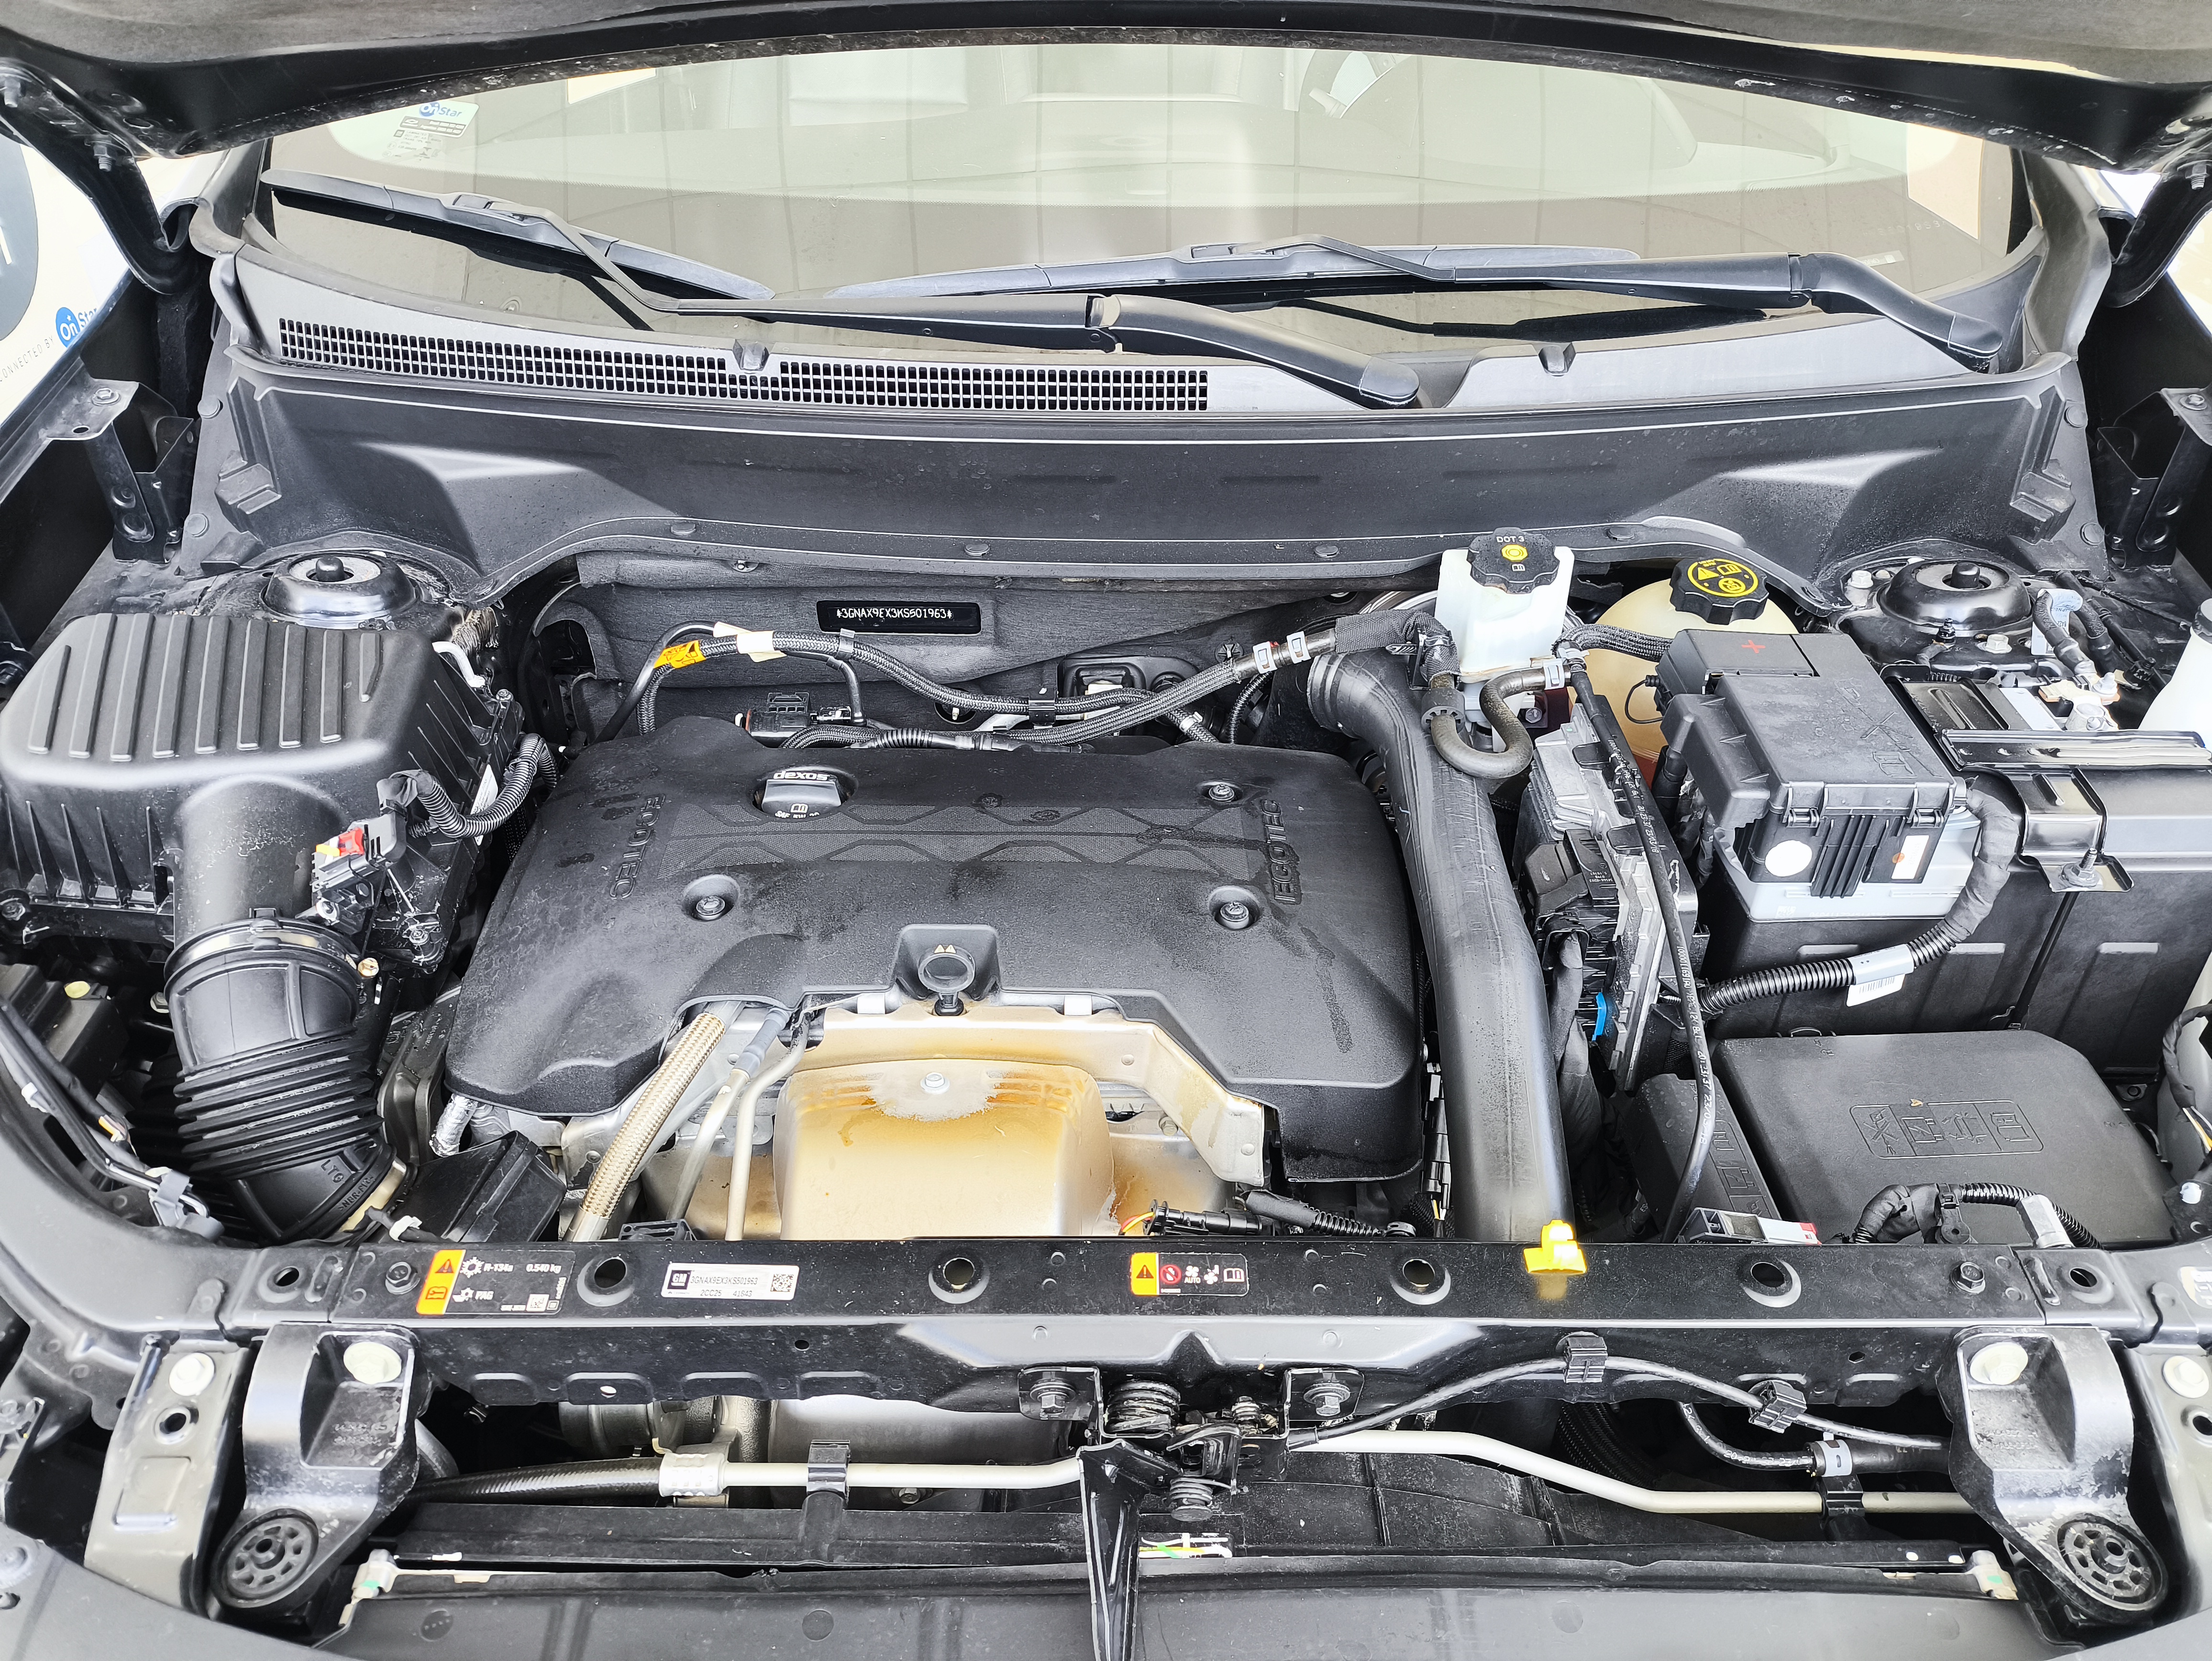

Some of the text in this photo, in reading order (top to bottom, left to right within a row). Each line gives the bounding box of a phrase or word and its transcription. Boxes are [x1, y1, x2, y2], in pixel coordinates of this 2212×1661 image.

[419, 102, 462, 117] OnStar
[44, 335, 55, 348] BY
[773, 771, 830, 781] dexos
[609, 793, 666, 900] ECOTEC
[1261, 799, 1296, 902] ECOTEC
[321, 1159, 344, 1183] LTG
[483, 1263, 562, 1273] R-134a 0.540 kg
[672, 1273, 687, 1284] GM
[475, 1291, 494, 1300] PAG
